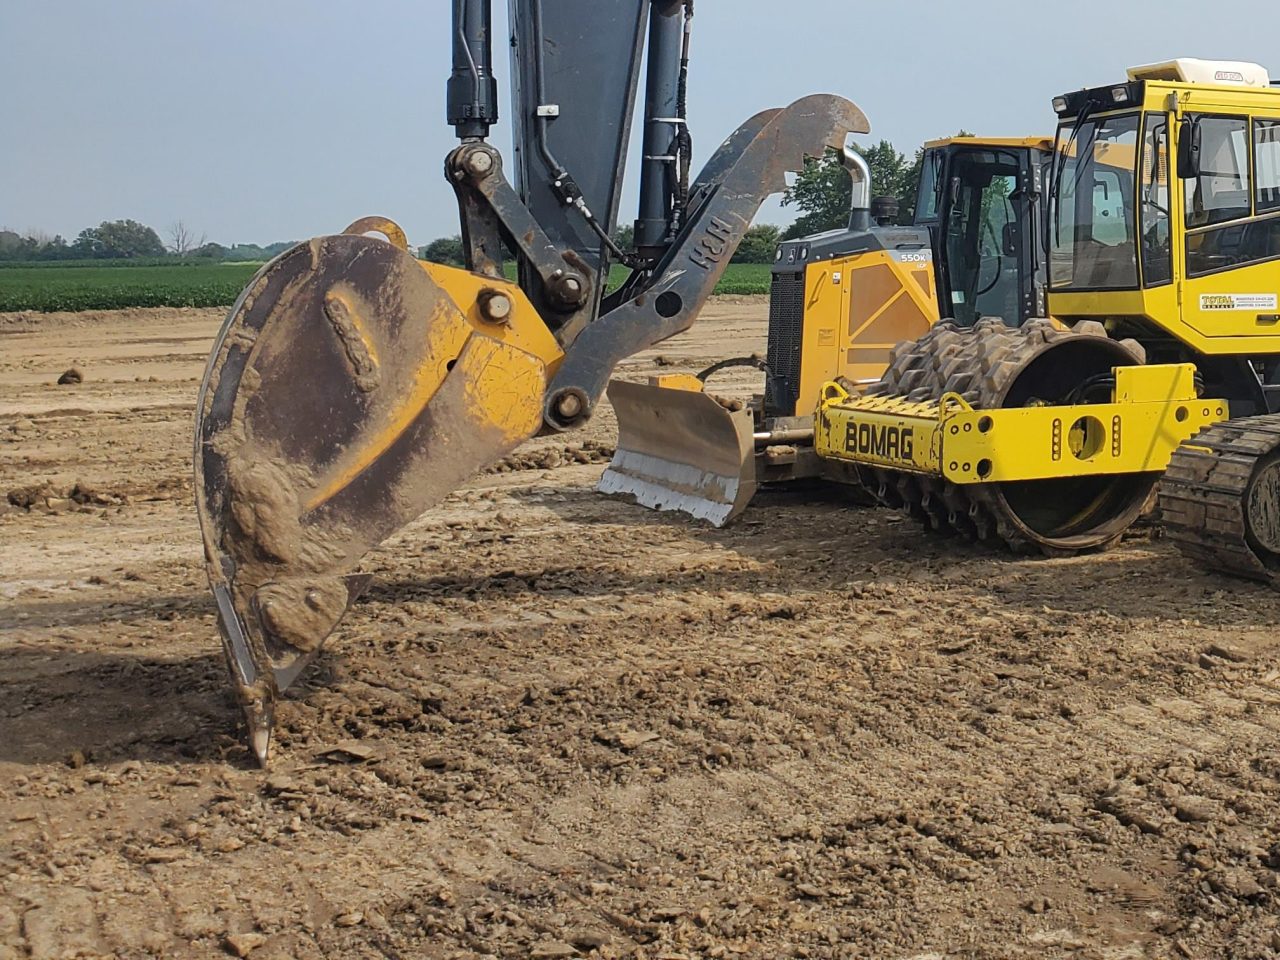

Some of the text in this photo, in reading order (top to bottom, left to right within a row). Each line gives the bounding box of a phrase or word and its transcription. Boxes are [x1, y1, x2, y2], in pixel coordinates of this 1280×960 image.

[689, 216, 733, 270] H&H
[901, 254, 926, 262] 550K
[1202, 296, 1234, 304] TOTAL
[845, 421, 913, 460] BOMAG
